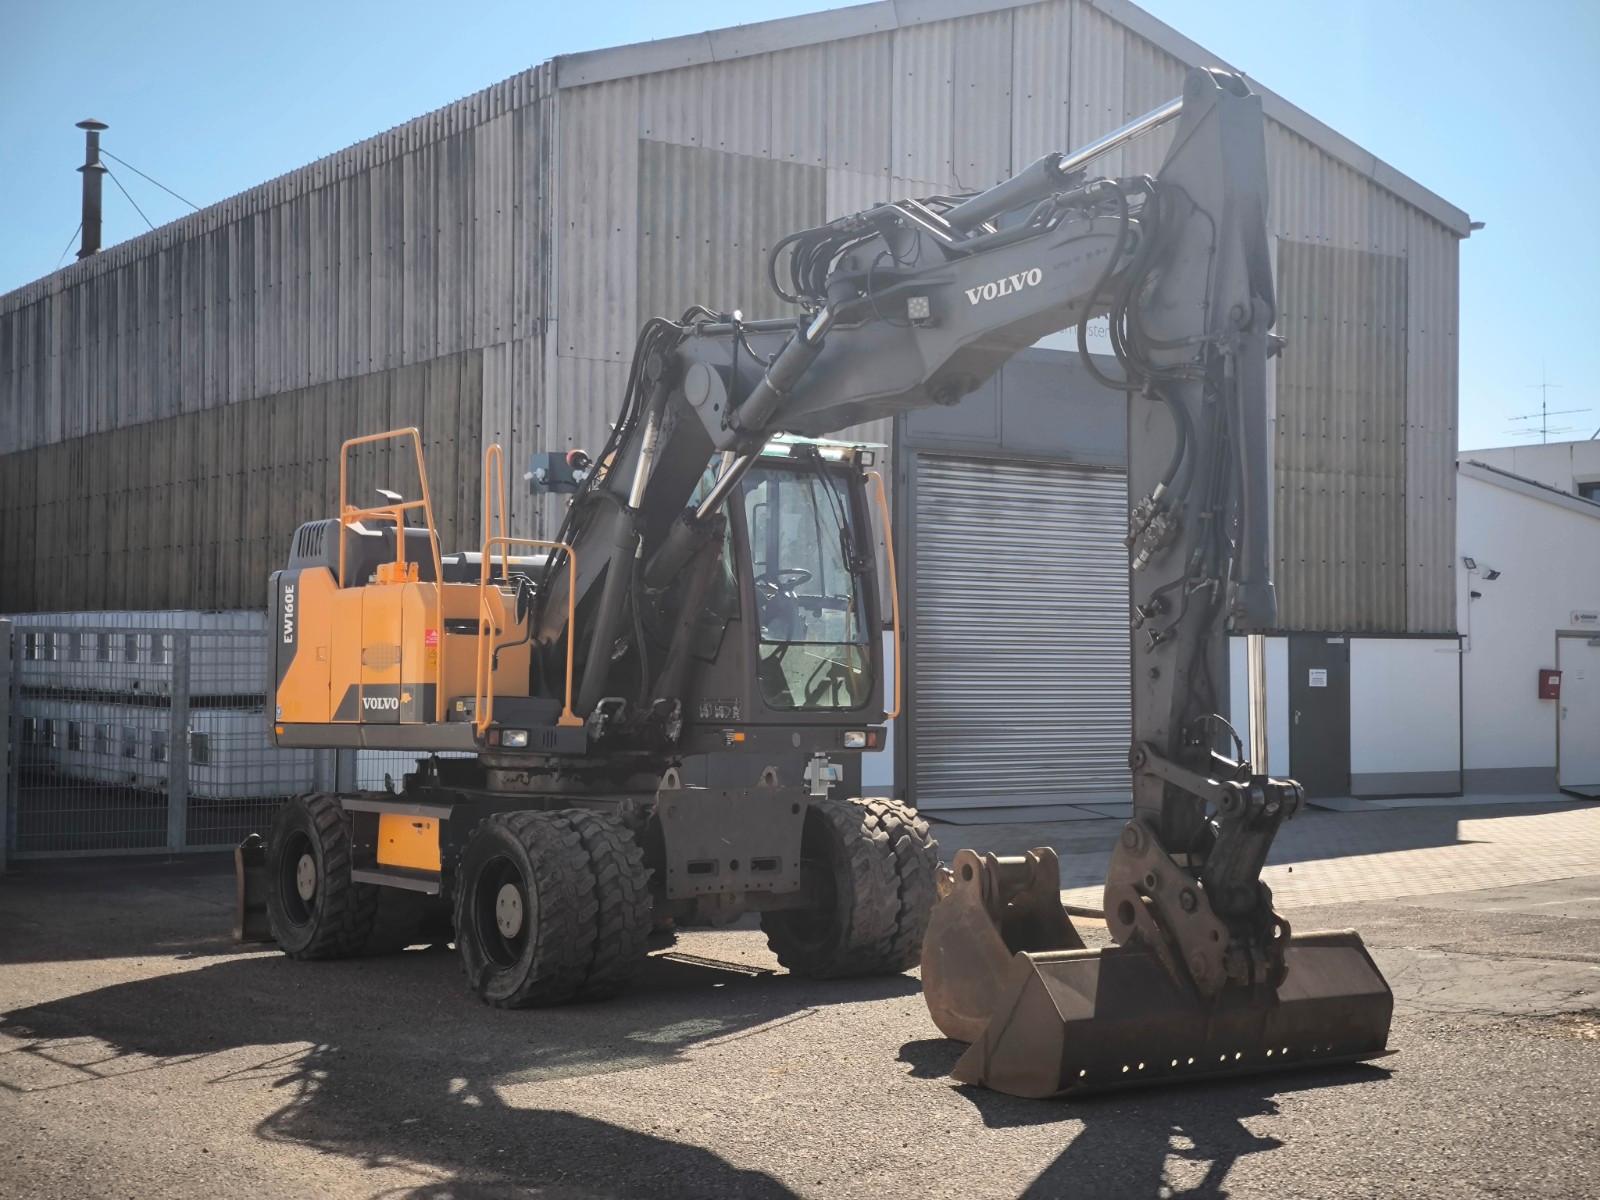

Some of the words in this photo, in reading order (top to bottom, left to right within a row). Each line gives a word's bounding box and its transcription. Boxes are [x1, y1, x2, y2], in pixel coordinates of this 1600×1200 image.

[964, 267, 1042, 305] VOLVO
[283, 584, 294, 644] EW160E
[362, 697, 399, 710] VOLVO
